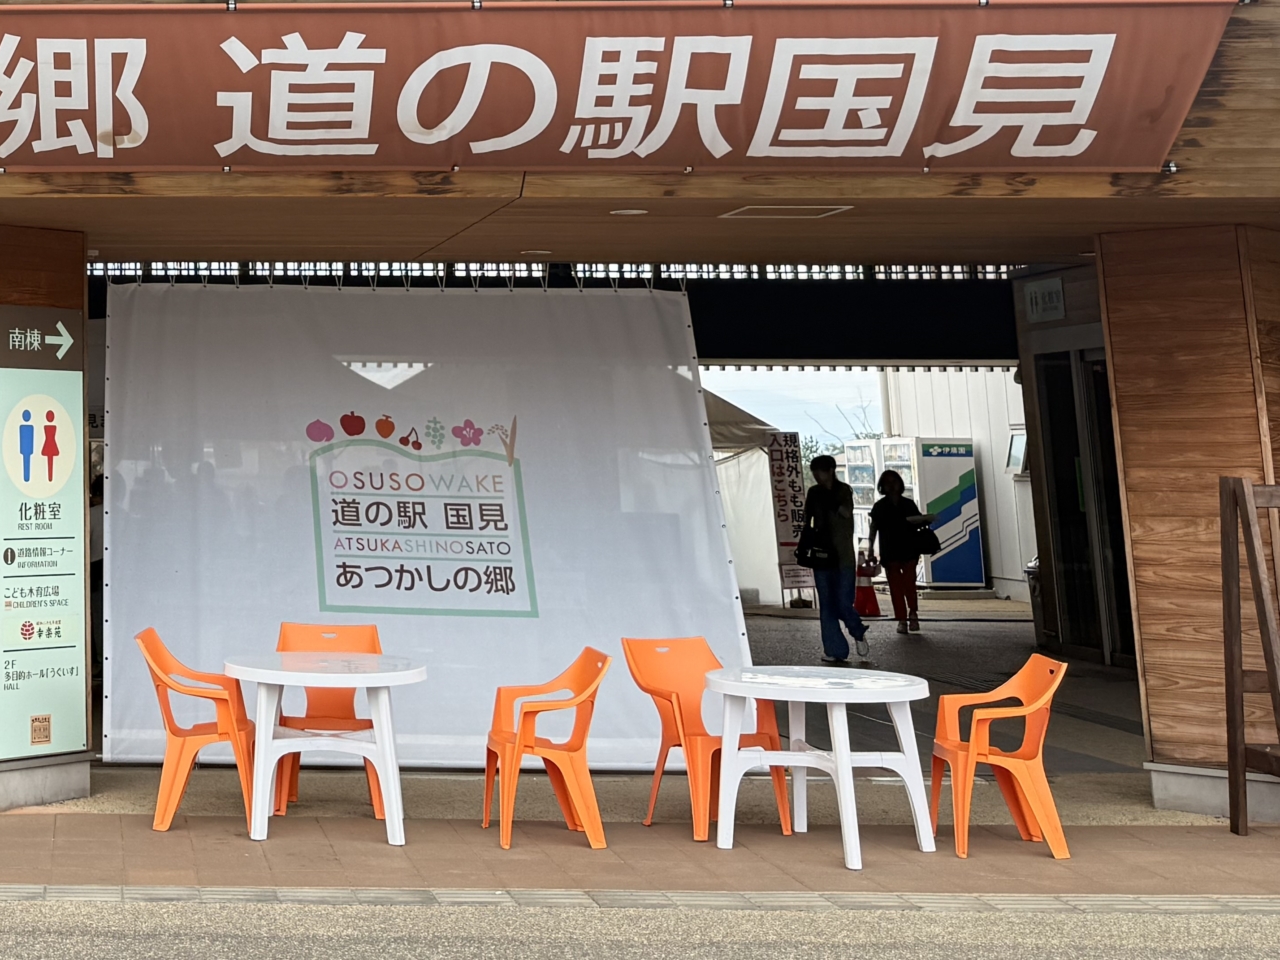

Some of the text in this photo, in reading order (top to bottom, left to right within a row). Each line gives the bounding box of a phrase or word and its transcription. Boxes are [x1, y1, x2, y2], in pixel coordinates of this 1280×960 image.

[213, 31, 1117, 159] 道の駅国見
[9, 327, 42, 351] 南棟
[329, 470, 505, 493] OSUSOWAKE
[768, 434, 790, 523] 入口はこちら
[19, 502, 62, 521] 化粧室
[331, 498, 509, 532] 道の駅 国見
[17, 522, 53, 531] REST ROOM
[17, 547, 74, 558] 道路情報コーナー
[333, 537, 512, 556] ATSUKASHINOSATO
[17, 560, 58, 569] INFORMATION
[336, 562, 517, 596] あつかしの郷
[4, 586, 60, 599] こども木育広場
[13, 599, 69, 609] CHILDREN'S SPACE
[4, 659, 17, 670] 2F
[3, 683, 20, 691] HALL
